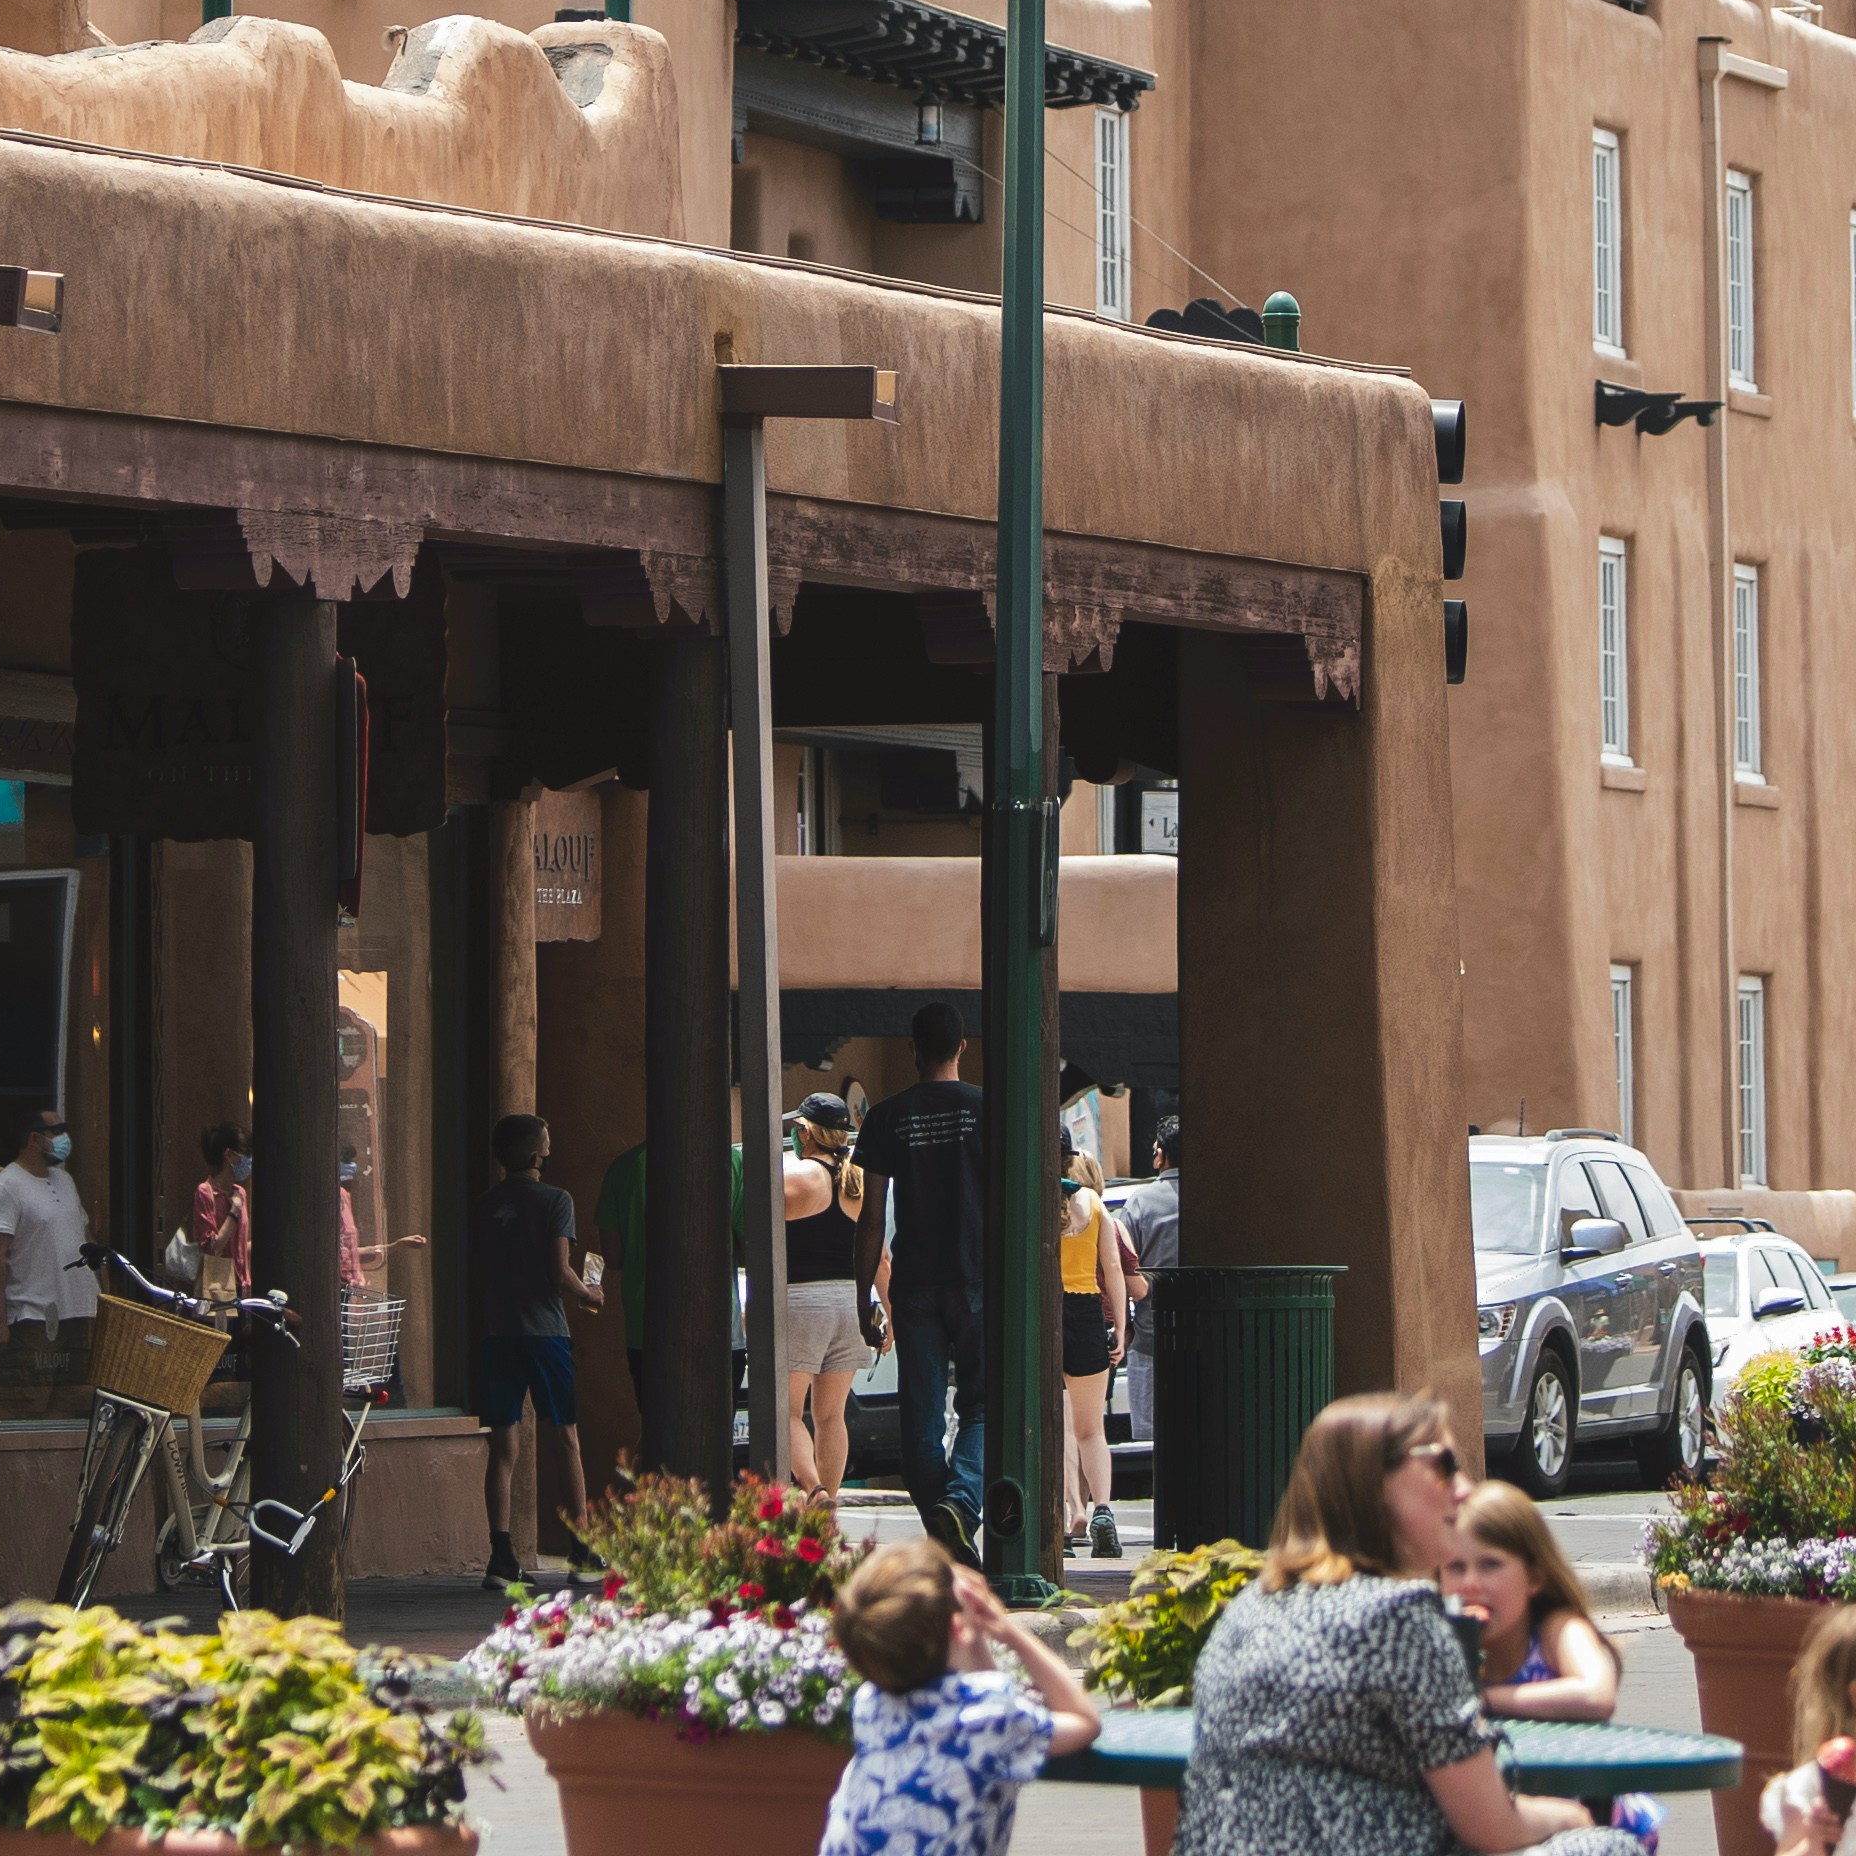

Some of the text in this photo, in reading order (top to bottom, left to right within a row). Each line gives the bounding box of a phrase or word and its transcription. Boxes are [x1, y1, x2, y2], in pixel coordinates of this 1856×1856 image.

[533, 831, 596, 882] ALOUF
[536, 887, 584, 905] THE PLAZA
